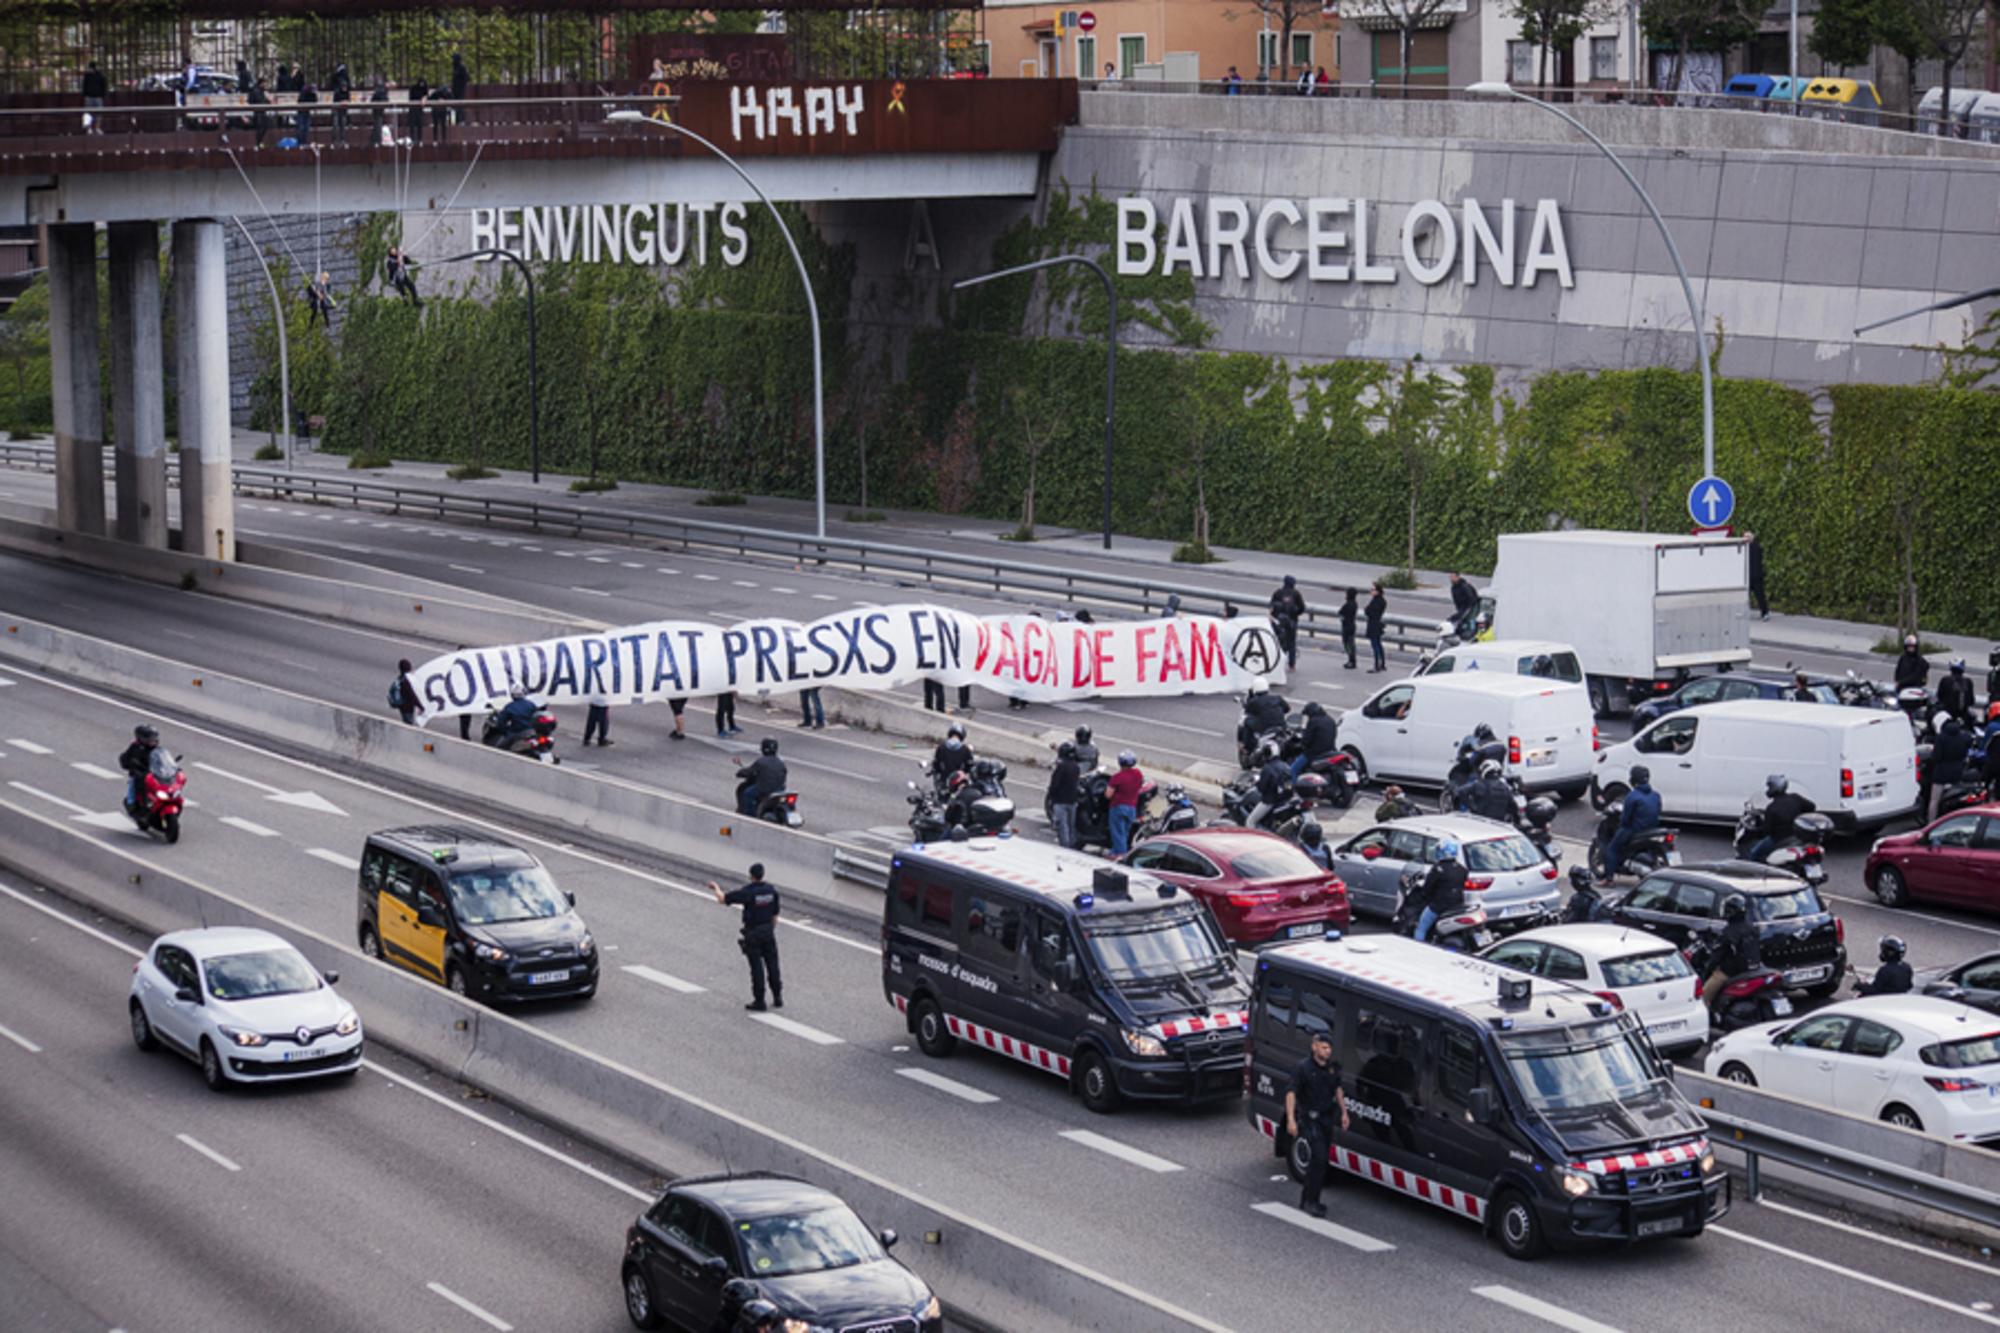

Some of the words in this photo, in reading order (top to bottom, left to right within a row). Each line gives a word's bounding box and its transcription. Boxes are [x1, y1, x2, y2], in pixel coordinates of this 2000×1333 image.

[472, 201, 748, 266] BENVINGUTS
[904, 199, 940, 269] A
[1117, 198, 1574, 287] BARCELONA
[424, 631, 703, 711] SOLIDARITAT
[722, 613, 896, 685] PRESXS
[909, 611, 961, 670] EN
[974, 622, 1058, 687] VAGA
[1072, 628, 1115, 688] DE
[1135, 622, 1227, 682] FAM
